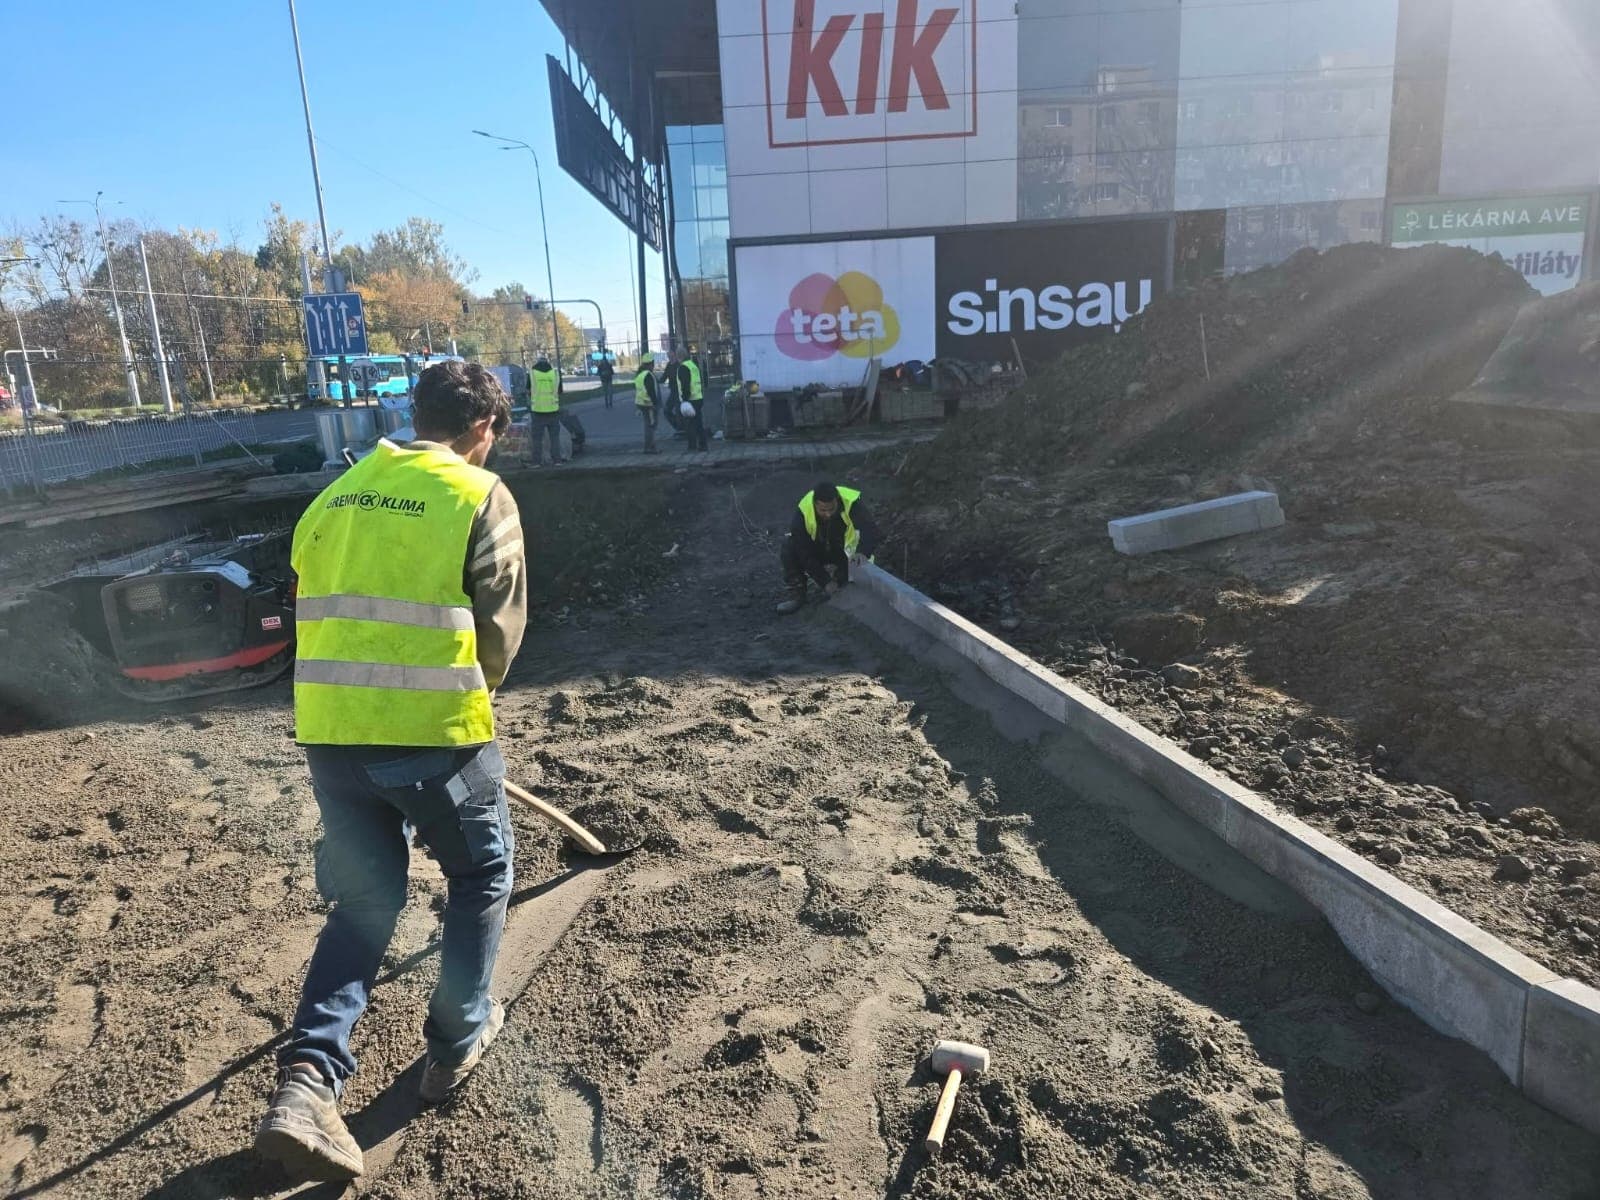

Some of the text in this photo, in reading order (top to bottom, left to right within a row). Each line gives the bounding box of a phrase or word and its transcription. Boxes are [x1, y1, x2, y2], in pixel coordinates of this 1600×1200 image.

[1429, 207, 1580, 229] LÉKÁRNA AVE
[947, 278, 1152, 335] sinsay
[790, 305, 886, 344] teta
[360, 494, 377, 506] GK
[380, 496, 425, 513] KLIMA
